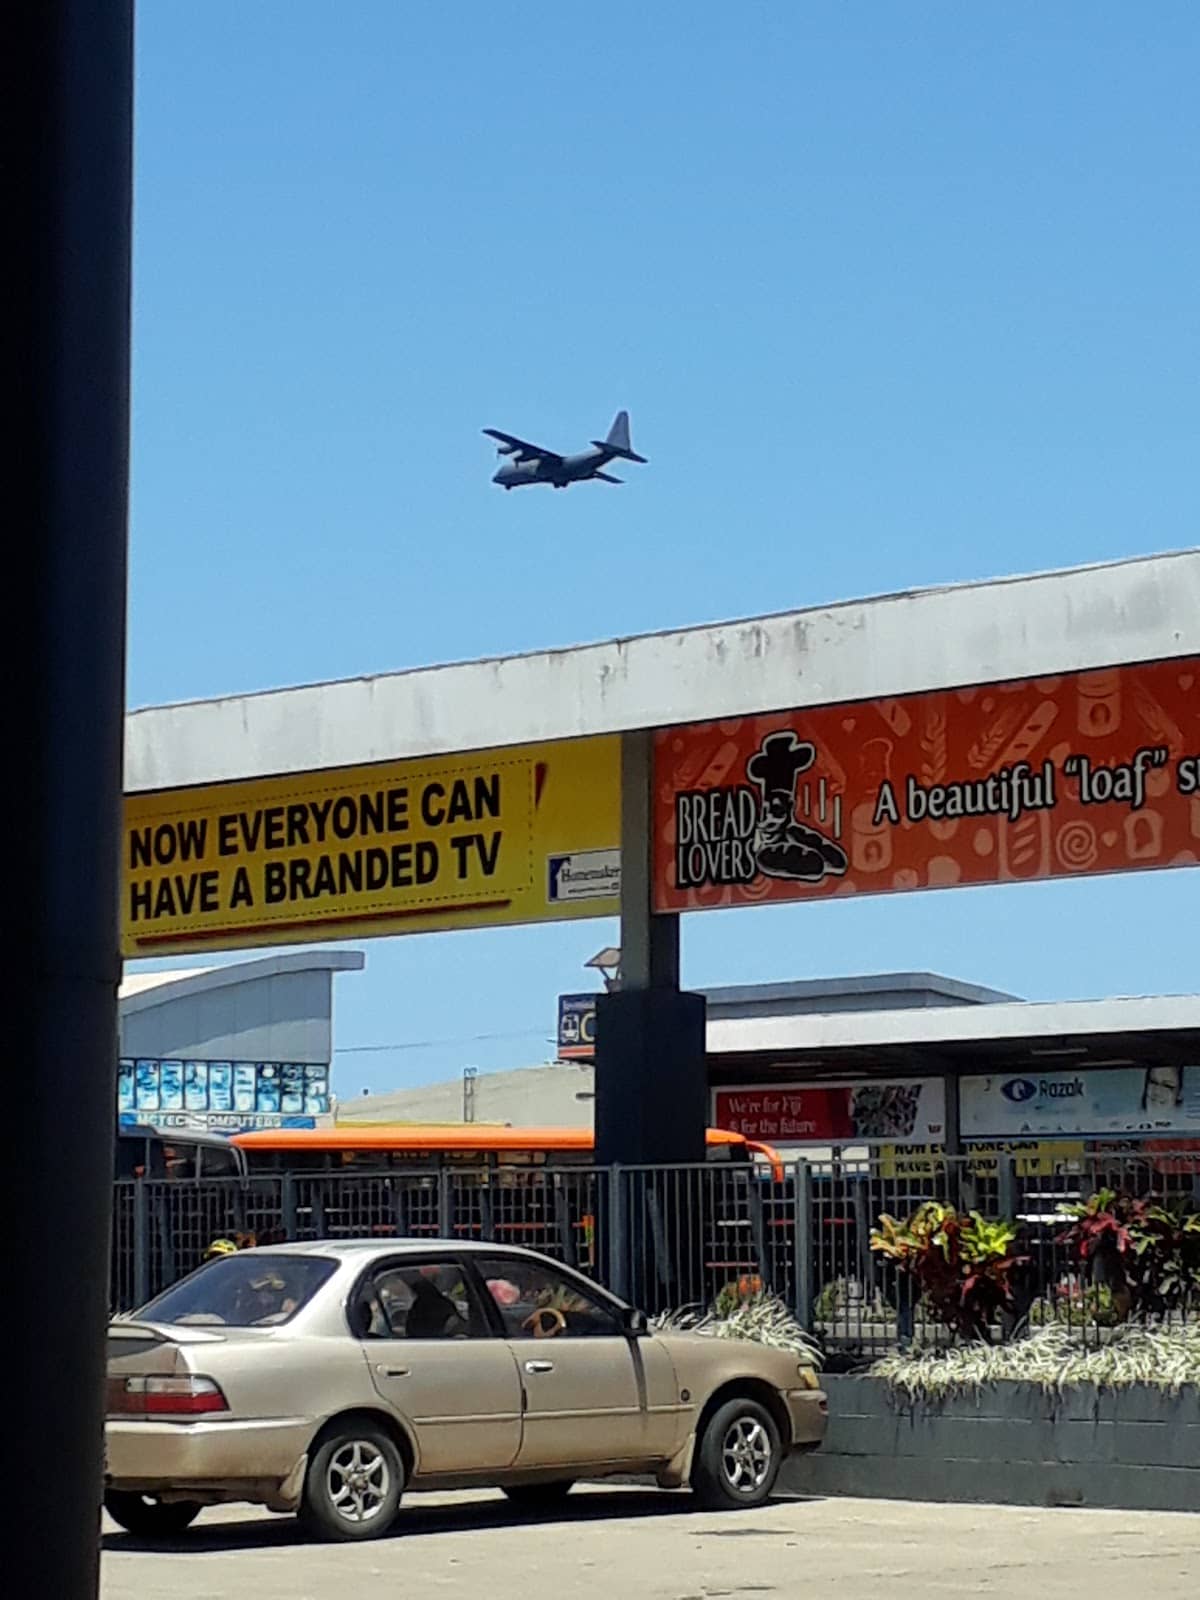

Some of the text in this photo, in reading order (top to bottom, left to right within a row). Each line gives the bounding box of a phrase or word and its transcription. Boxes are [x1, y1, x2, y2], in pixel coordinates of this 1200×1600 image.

[130, 774, 500, 869] NOW EVERYONE CAN
[679, 790, 756, 844] BREAD
[875, 782, 898, 823] A
[908, 760, 1054, 820] beautiful
[1179, 758, 1200, 791] s
[130, 831, 502, 921] HAVE A BRANDED TV
[679, 840, 755, 884] LOVERS
